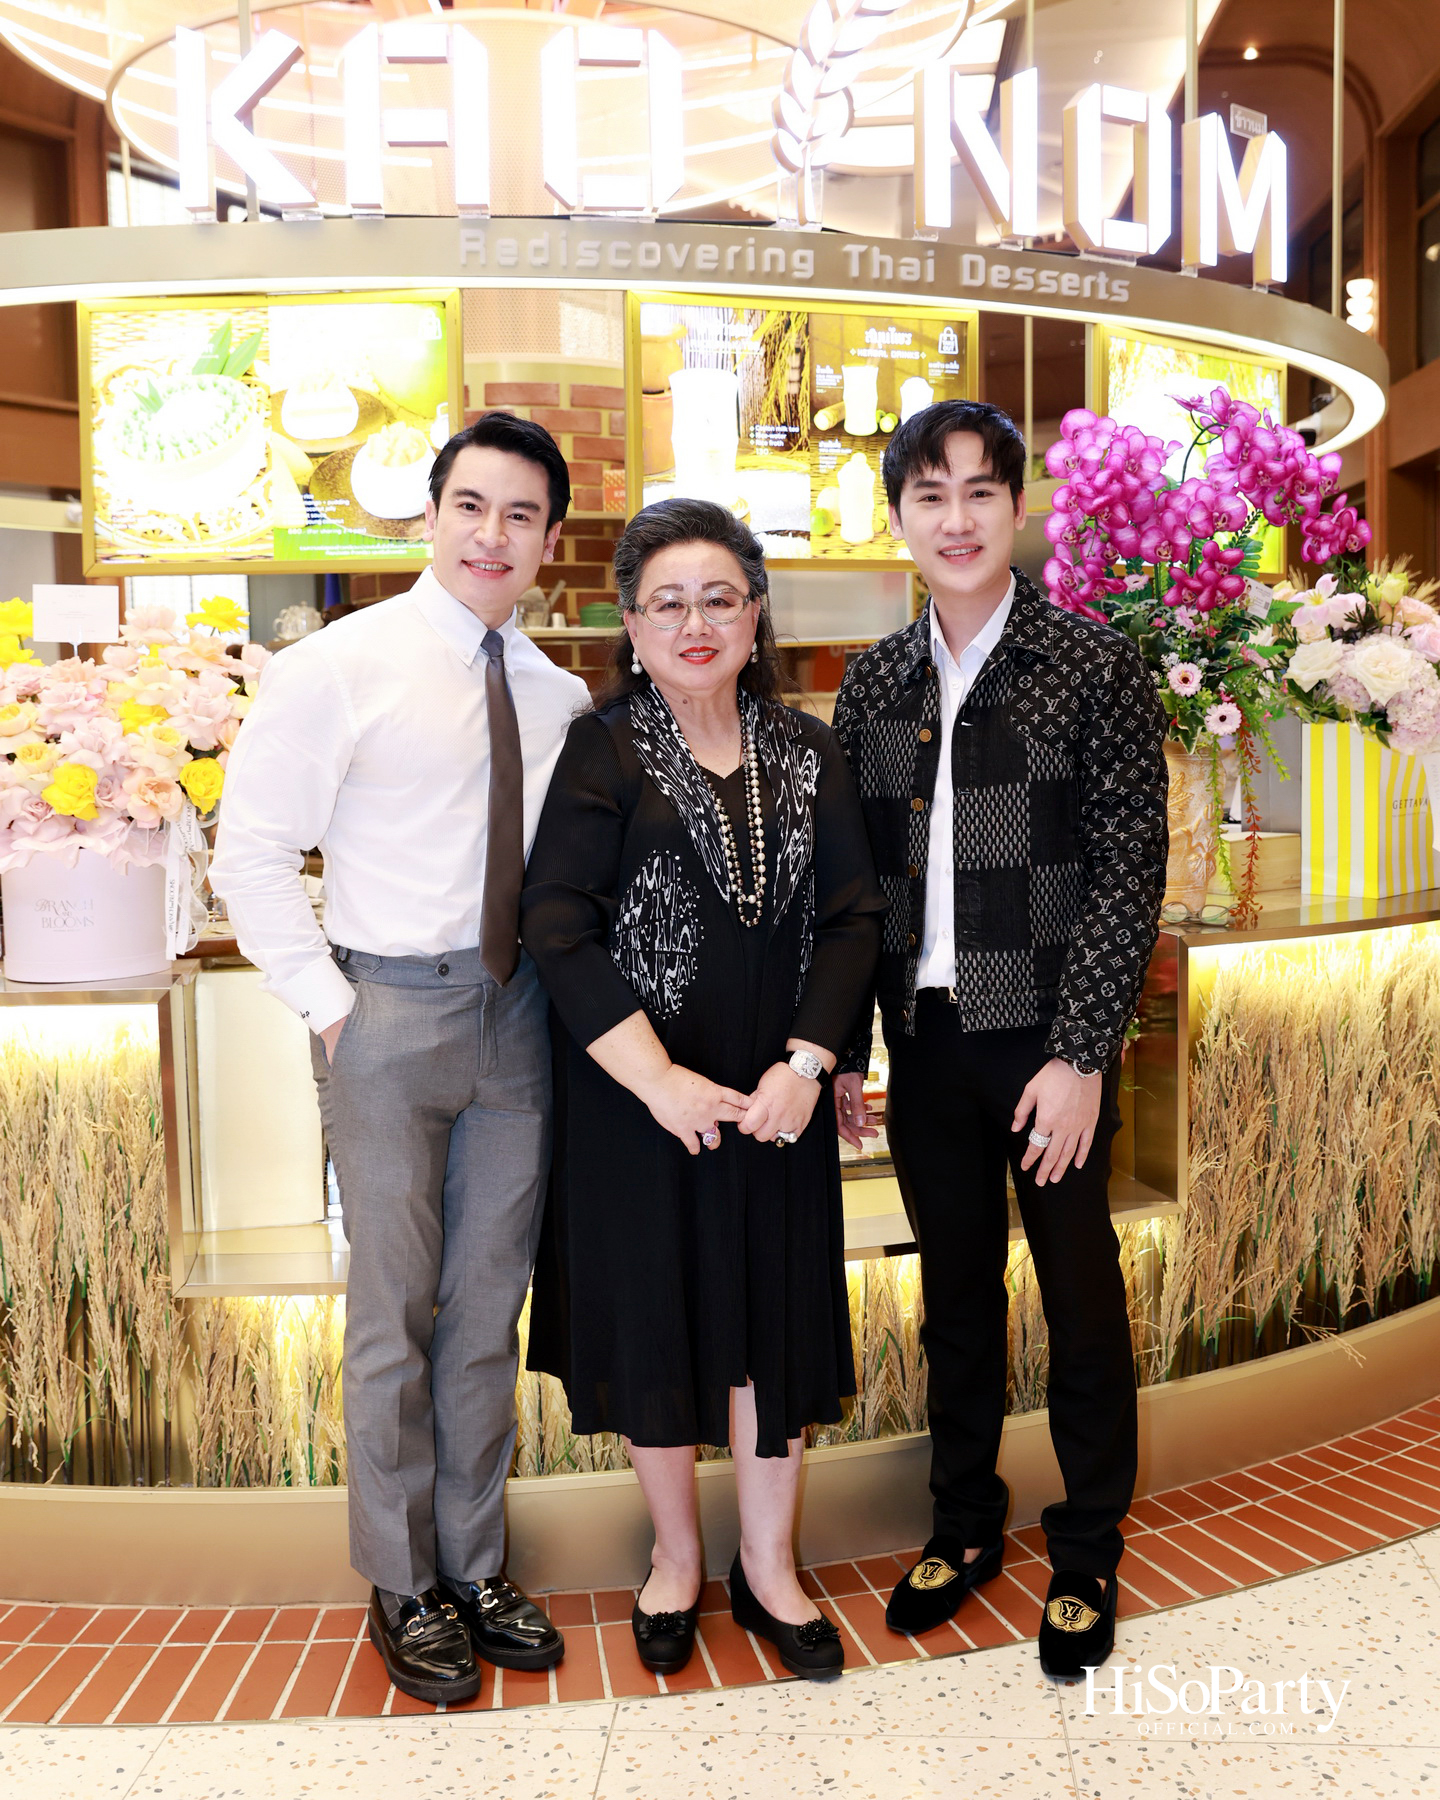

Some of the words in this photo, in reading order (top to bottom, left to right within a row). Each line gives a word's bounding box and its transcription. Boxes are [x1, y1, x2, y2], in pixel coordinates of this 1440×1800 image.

[176, 22, 684, 210] KAO
[914, 60, 1288, 285] NOM
[459, 227, 815, 279] Rediscovering
[842, 244, 935, 284] Thai
[960, 253, 1131, 303] Desserts
[857, 348, 888, 358] HERBAL
[890, 350, 920, 360] DRINKS
